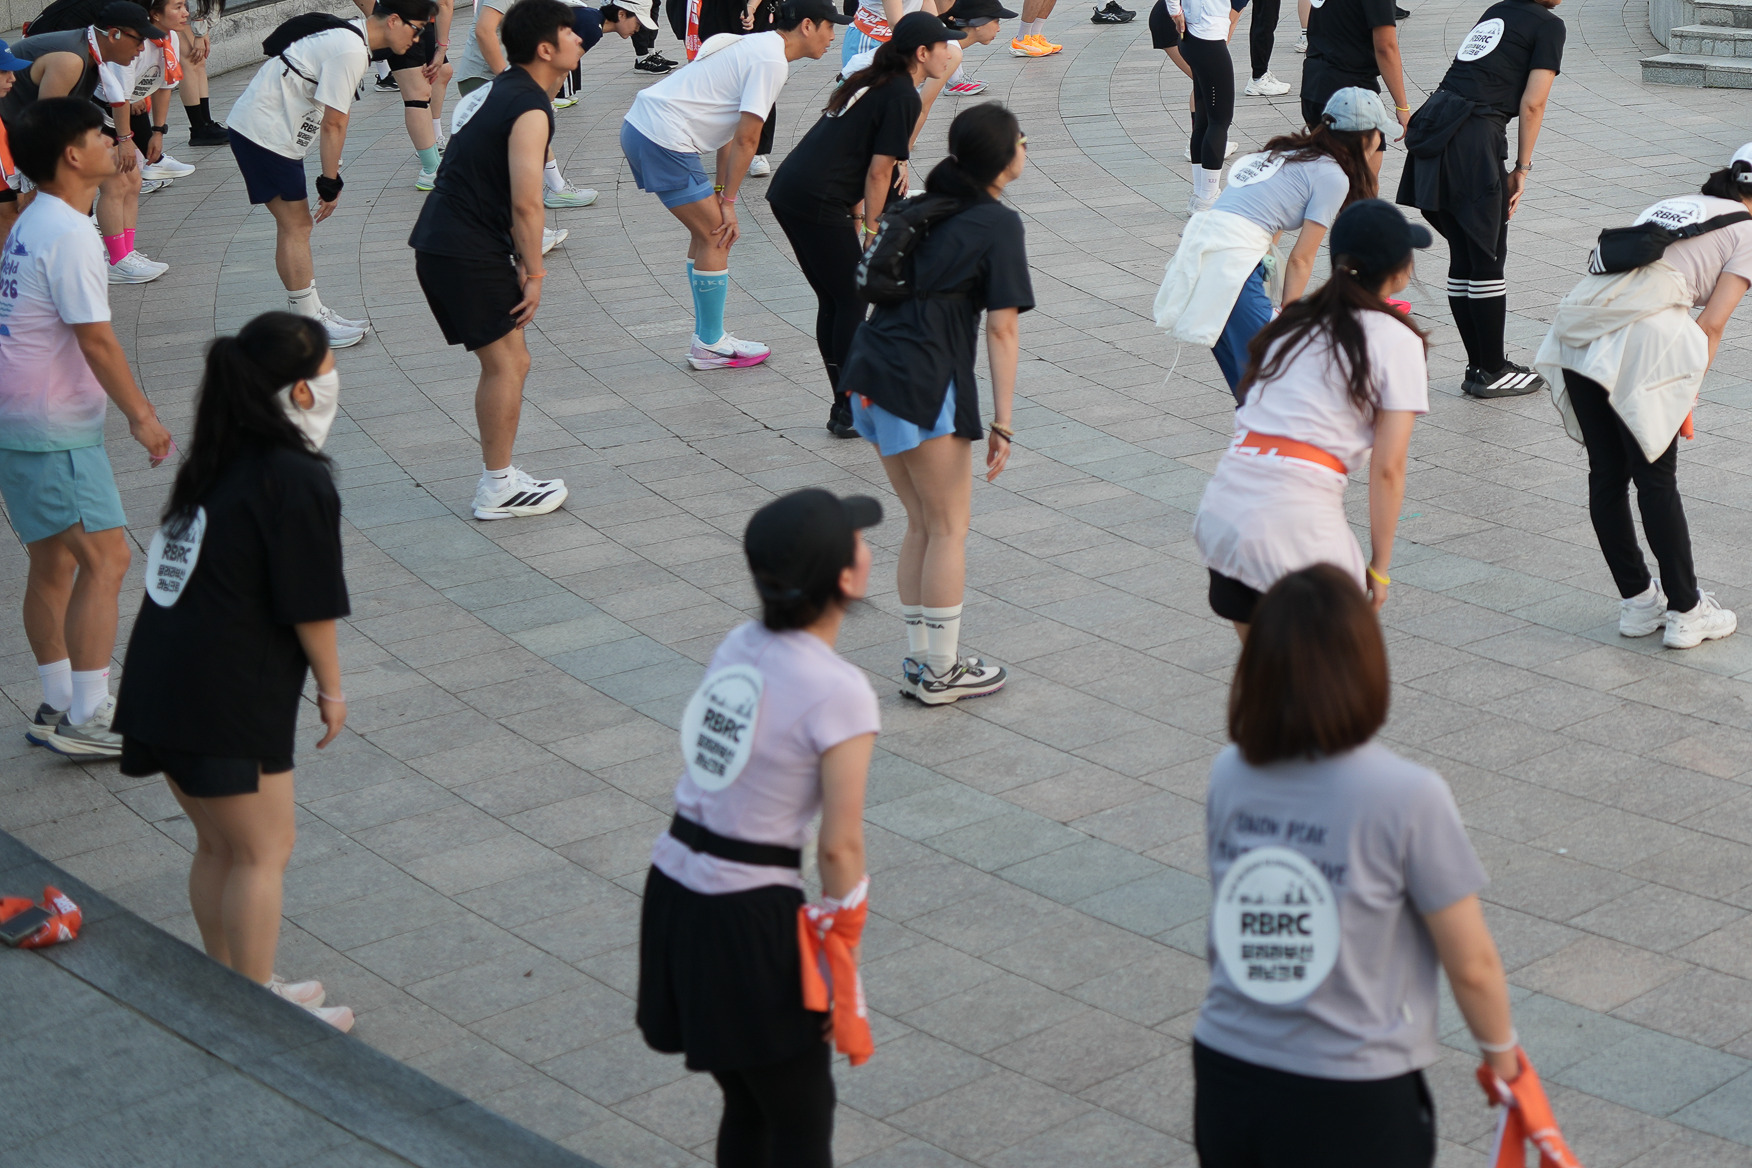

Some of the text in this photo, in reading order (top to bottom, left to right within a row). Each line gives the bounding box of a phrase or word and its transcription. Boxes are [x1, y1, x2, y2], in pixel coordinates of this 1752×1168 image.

[1651, 209, 1688, 223] RBRC
[162, 542, 193, 565] RBRC
[703, 707, 748, 744] RBRC
[1240, 911, 1313, 937] RBRC
